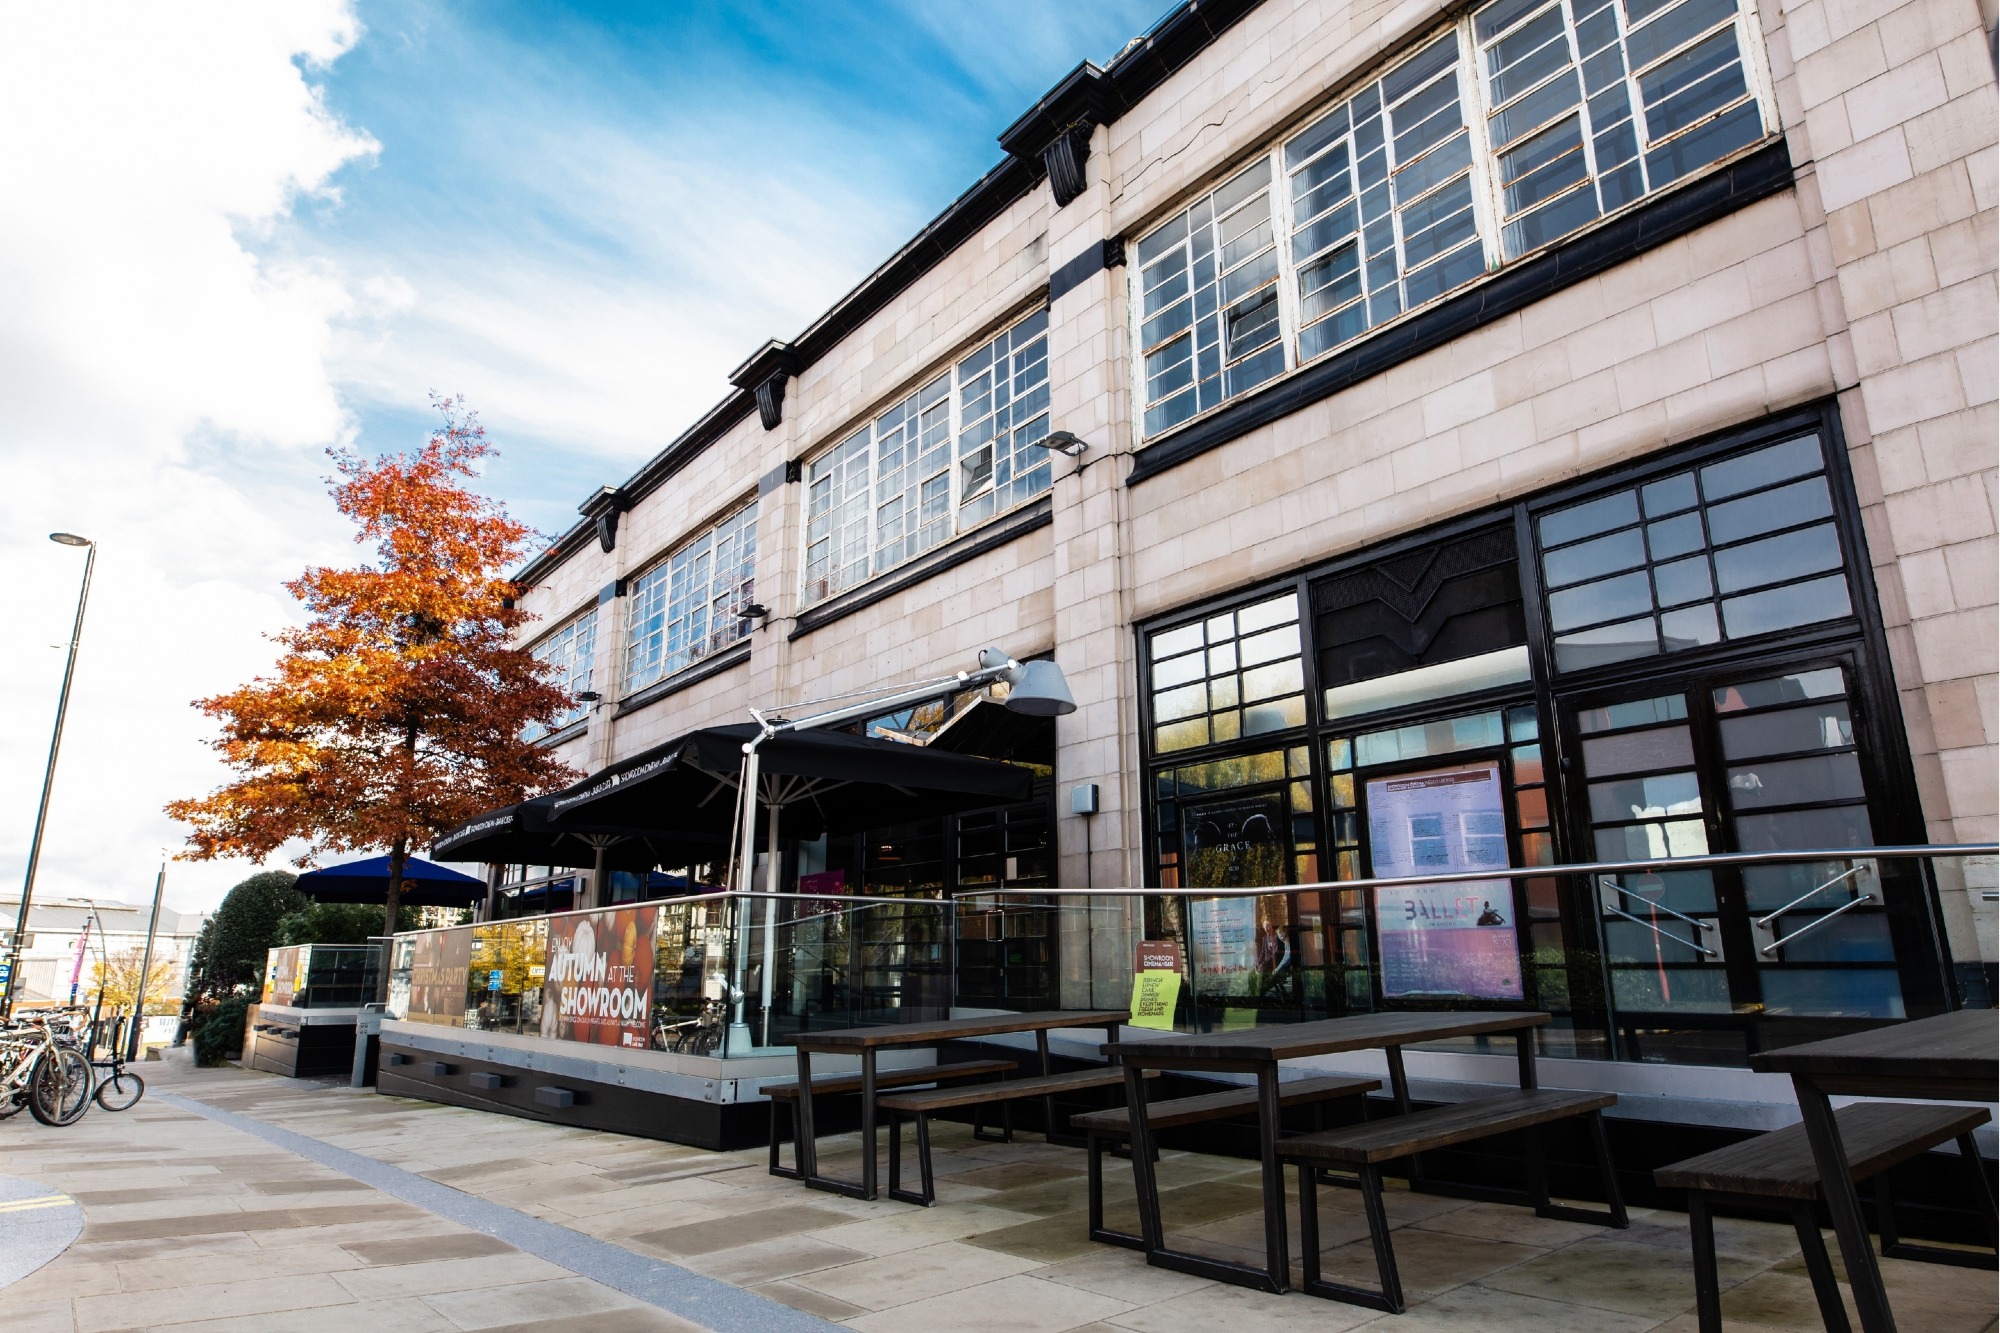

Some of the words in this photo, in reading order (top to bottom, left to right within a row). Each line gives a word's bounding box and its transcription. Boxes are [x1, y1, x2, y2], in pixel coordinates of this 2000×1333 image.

[1215, 841, 1251, 853] GRACE
[1404, 896, 1481, 921] BALLET
[551, 936, 573, 953] ENJOY
[412, 967, 445, 986] CHRISTMAS
[445, 967, 468, 986] PARTY
[548, 952, 607, 982] AUTUMN
[608, 966, 618, 983] AT
[619, 965, 635, 983] THE
[560, 986, 648, 1020] SHOWROOM
